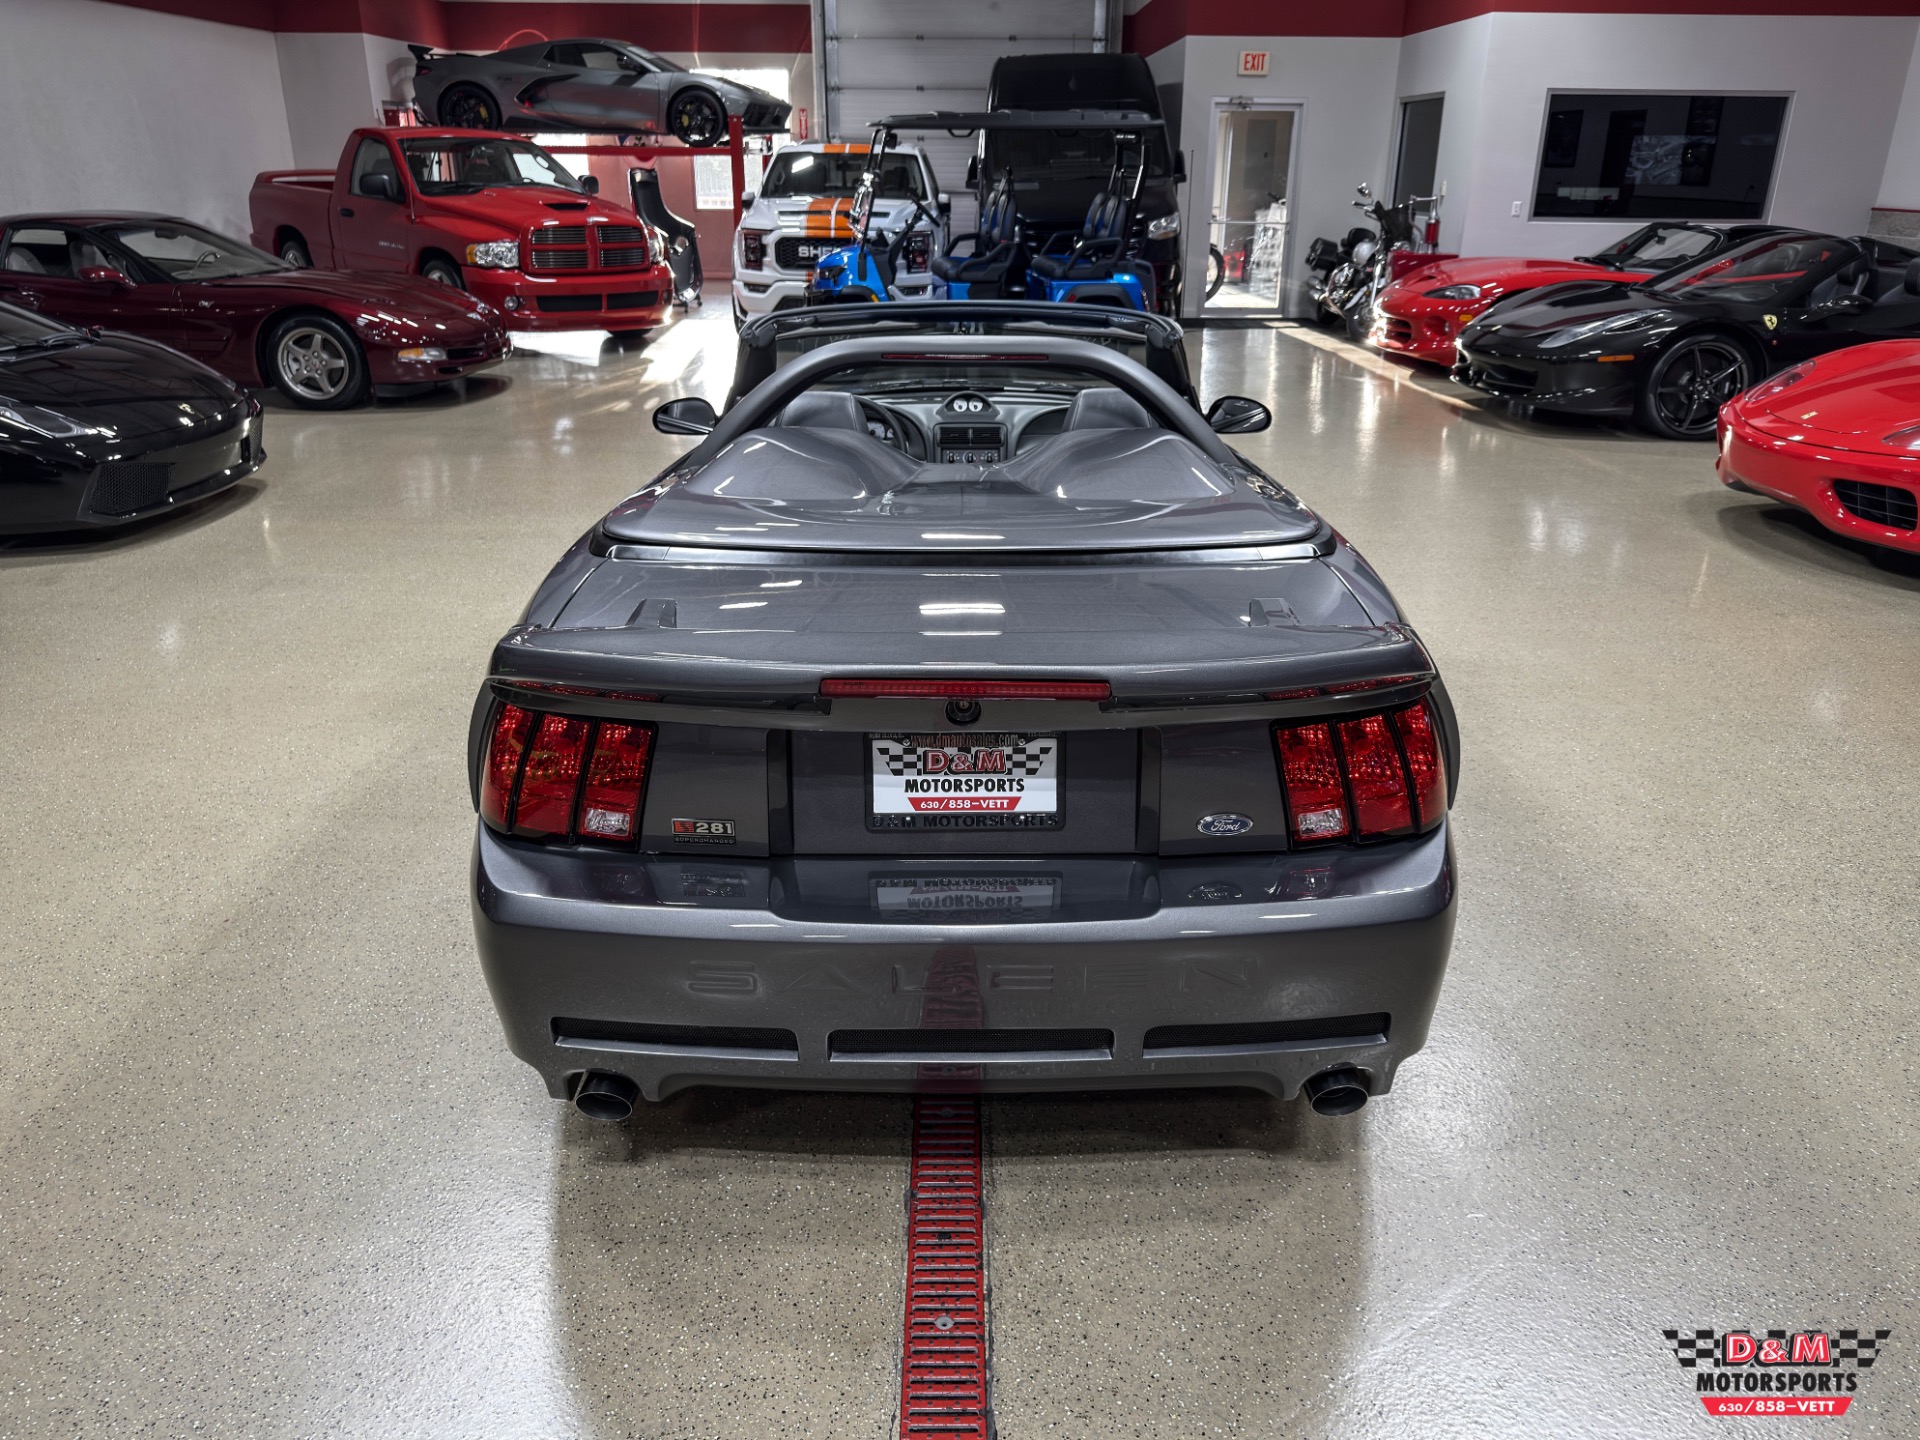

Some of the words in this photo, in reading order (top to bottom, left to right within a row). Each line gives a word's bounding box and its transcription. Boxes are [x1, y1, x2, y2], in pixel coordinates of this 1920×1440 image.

[1243, 53, 1266, 71] EXIT
[798, 246, 833, 258] SHE
[910, 732, 1019, 748] www.dmautosales.com
[924, 749, 1006, 774] D&M
[904, 778, 1025, 793] MOTORSPORTS
[920, 798, 1009, 810] 630/858-VETT
[923, 813, 1058, 828] MOTORSPORTS
[1210, 818, 1240, 831] Ford
[685, 960, 1254, 998] SALEEN
